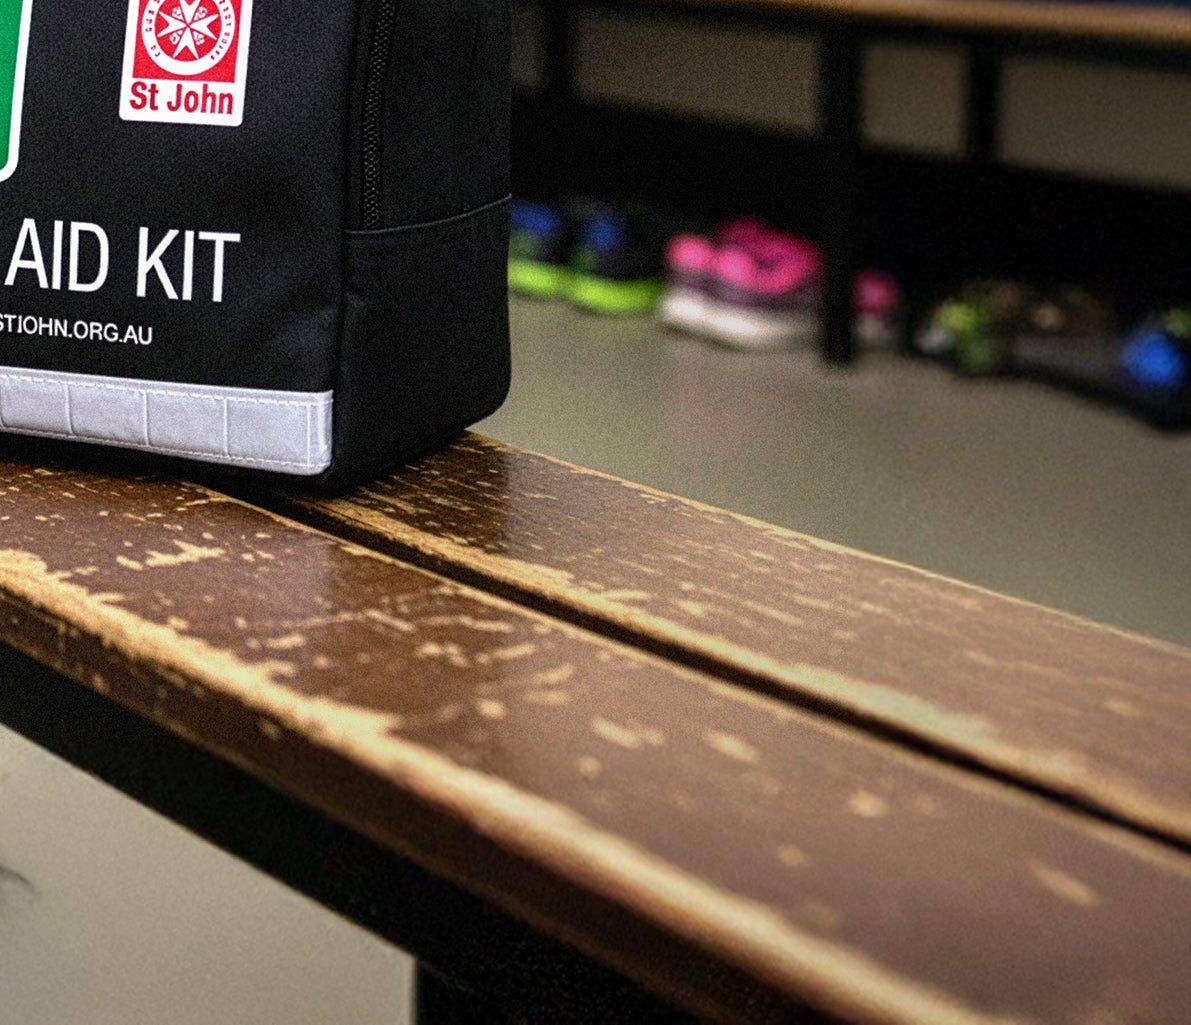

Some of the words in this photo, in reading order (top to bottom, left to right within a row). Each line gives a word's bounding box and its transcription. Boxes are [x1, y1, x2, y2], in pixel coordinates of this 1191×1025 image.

[129, 80, 159, 111] St
[166, 82, 234, 115] John
[4, 217, 110, 293] AID
[136, 226, 241, 303] KIT
